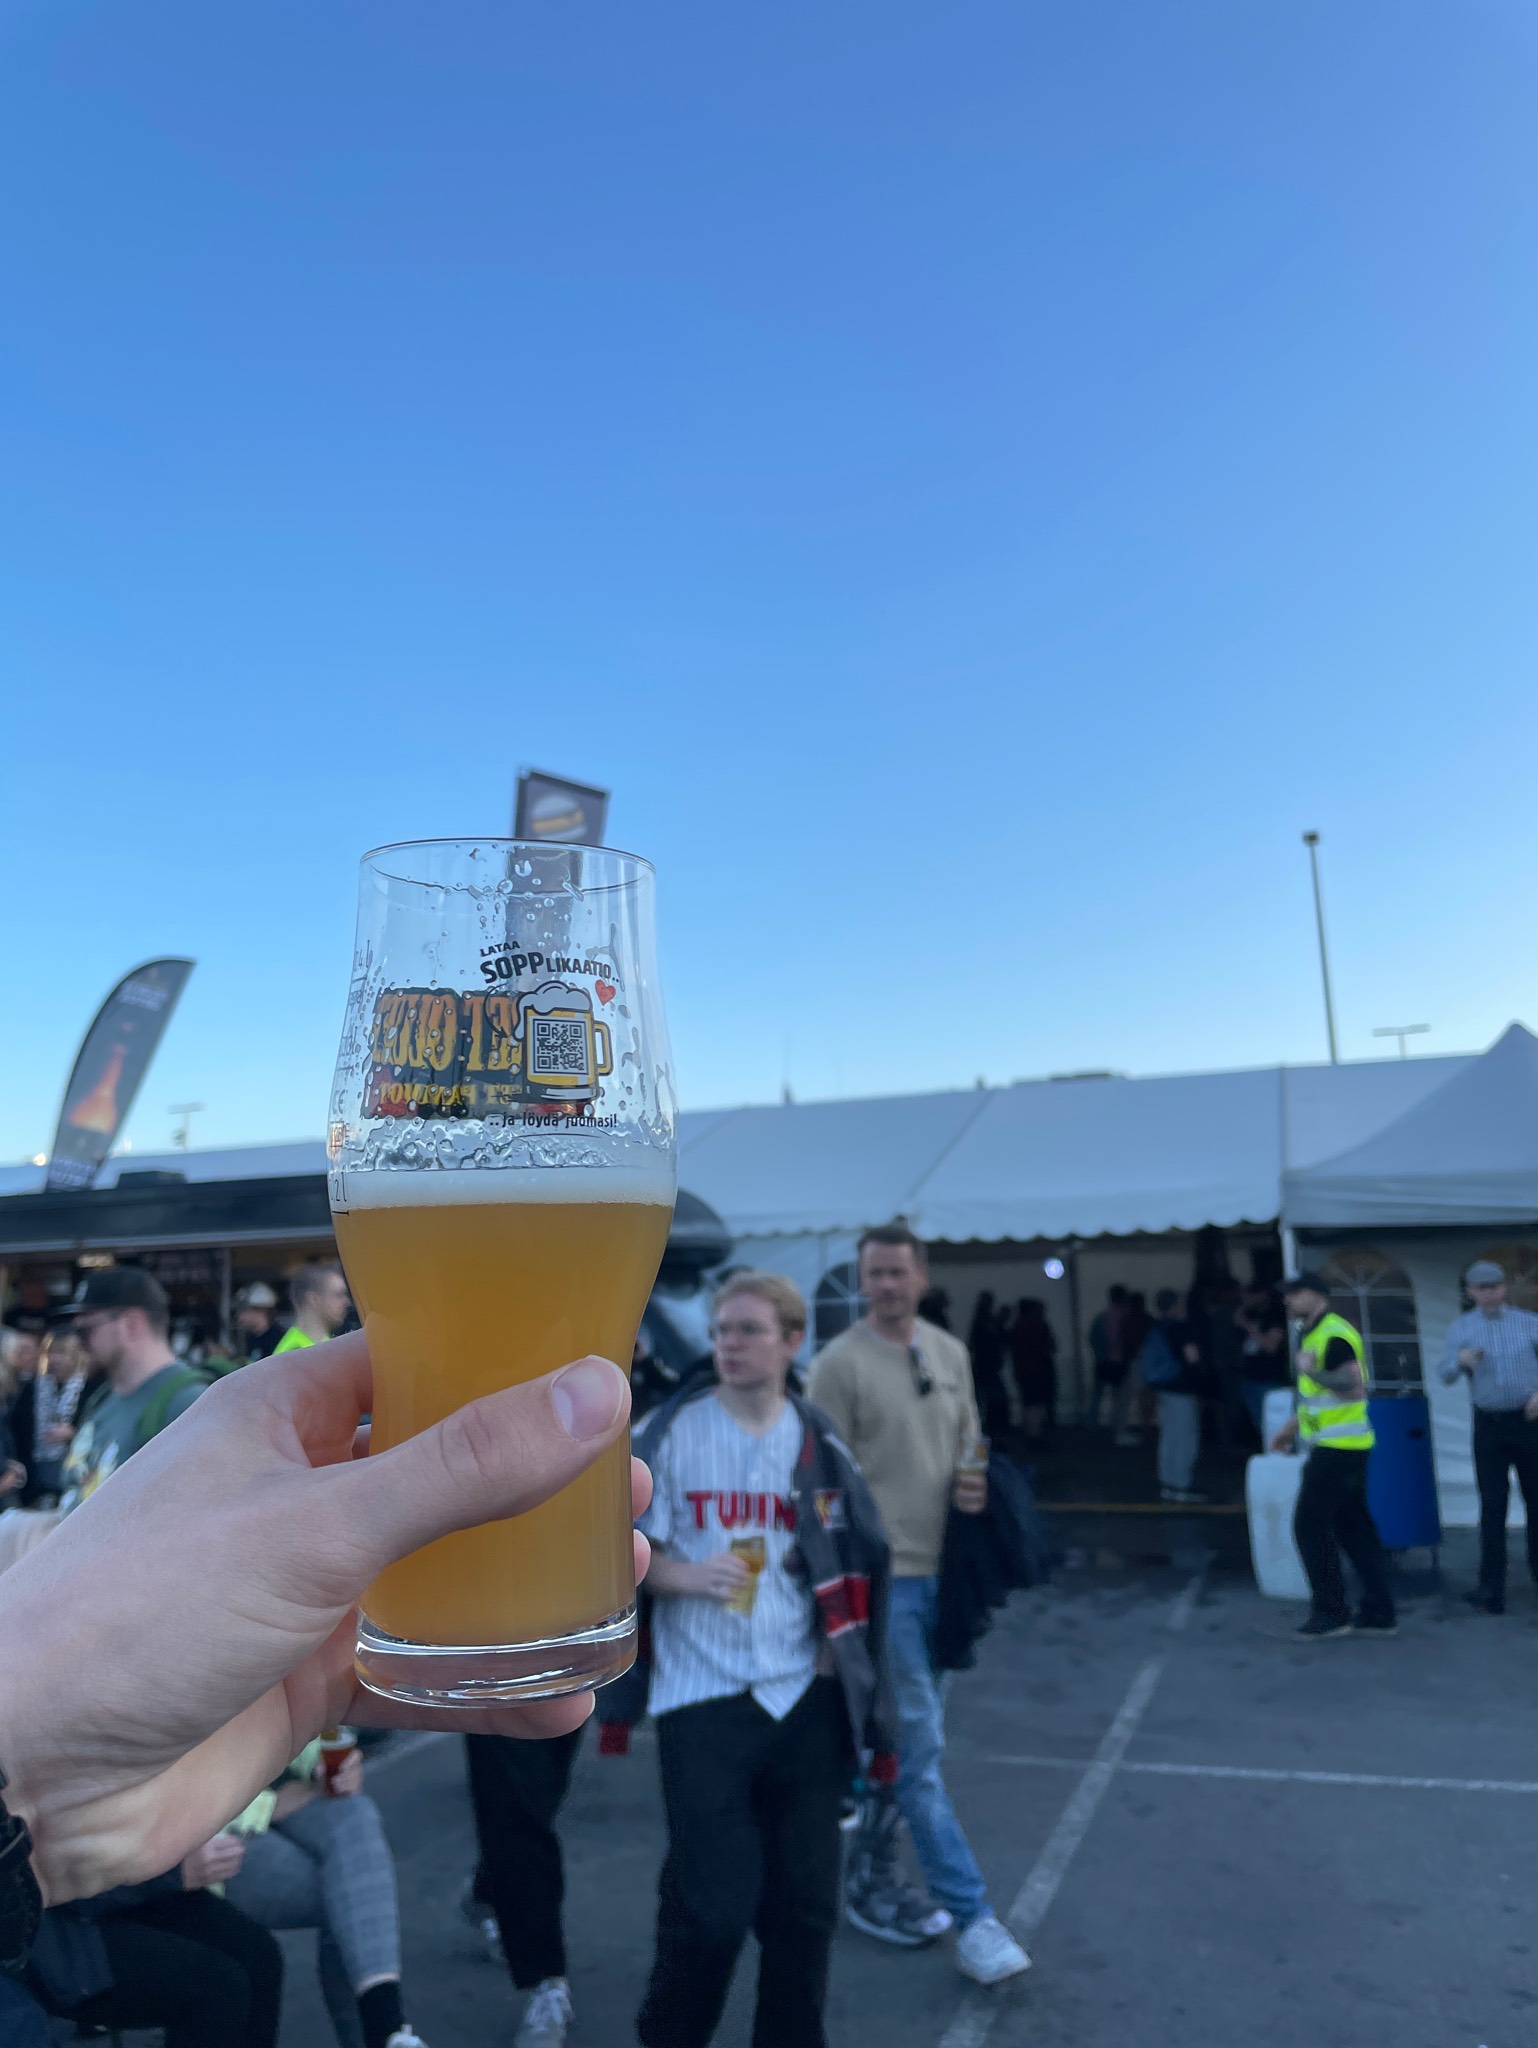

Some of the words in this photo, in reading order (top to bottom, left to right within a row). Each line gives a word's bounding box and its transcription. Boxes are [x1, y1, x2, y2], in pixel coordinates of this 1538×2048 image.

[480, 940, 520, 957] LATAA
[523, 1111, 559, 1128] löydä
[685, 1490, 799, 1531] TWIN
